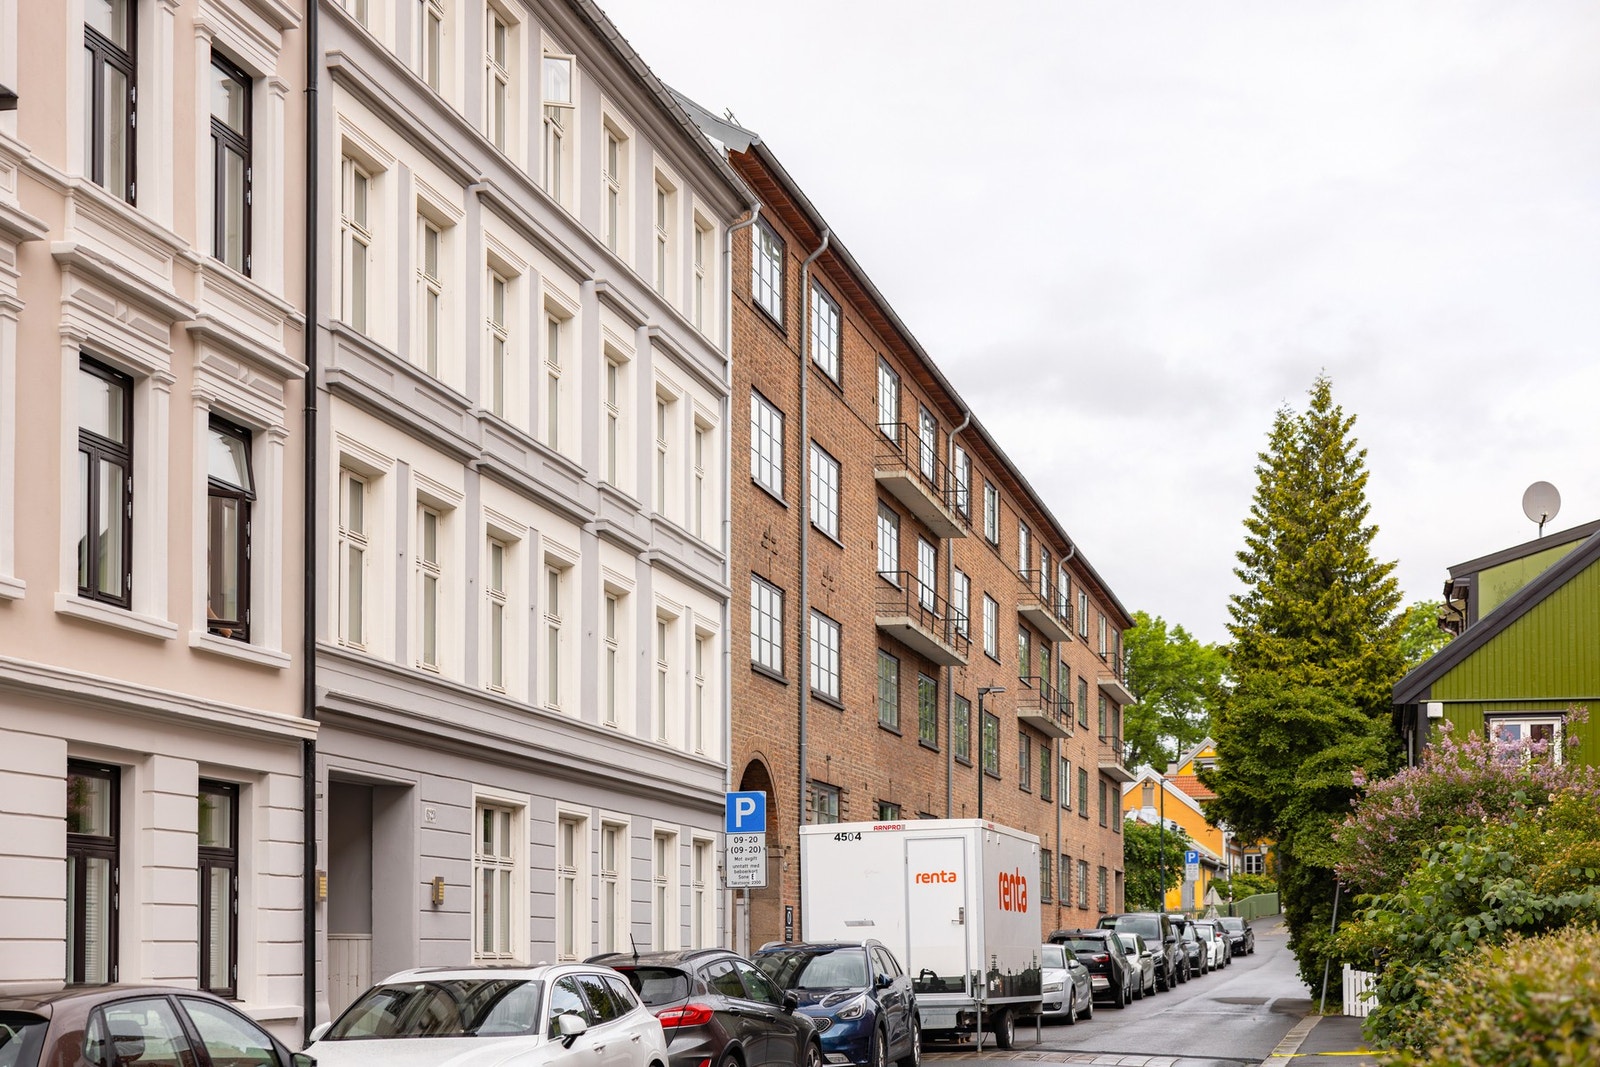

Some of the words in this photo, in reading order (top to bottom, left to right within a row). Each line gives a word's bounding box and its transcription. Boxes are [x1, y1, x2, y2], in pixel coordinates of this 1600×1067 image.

[736, 797, 756, 828] P
[834, 831, 862, 841] 4504
[1188, 852, 1196, 863] P
[915, 870, 957, 884] renta
[998, 866, 1027, 913] renta
